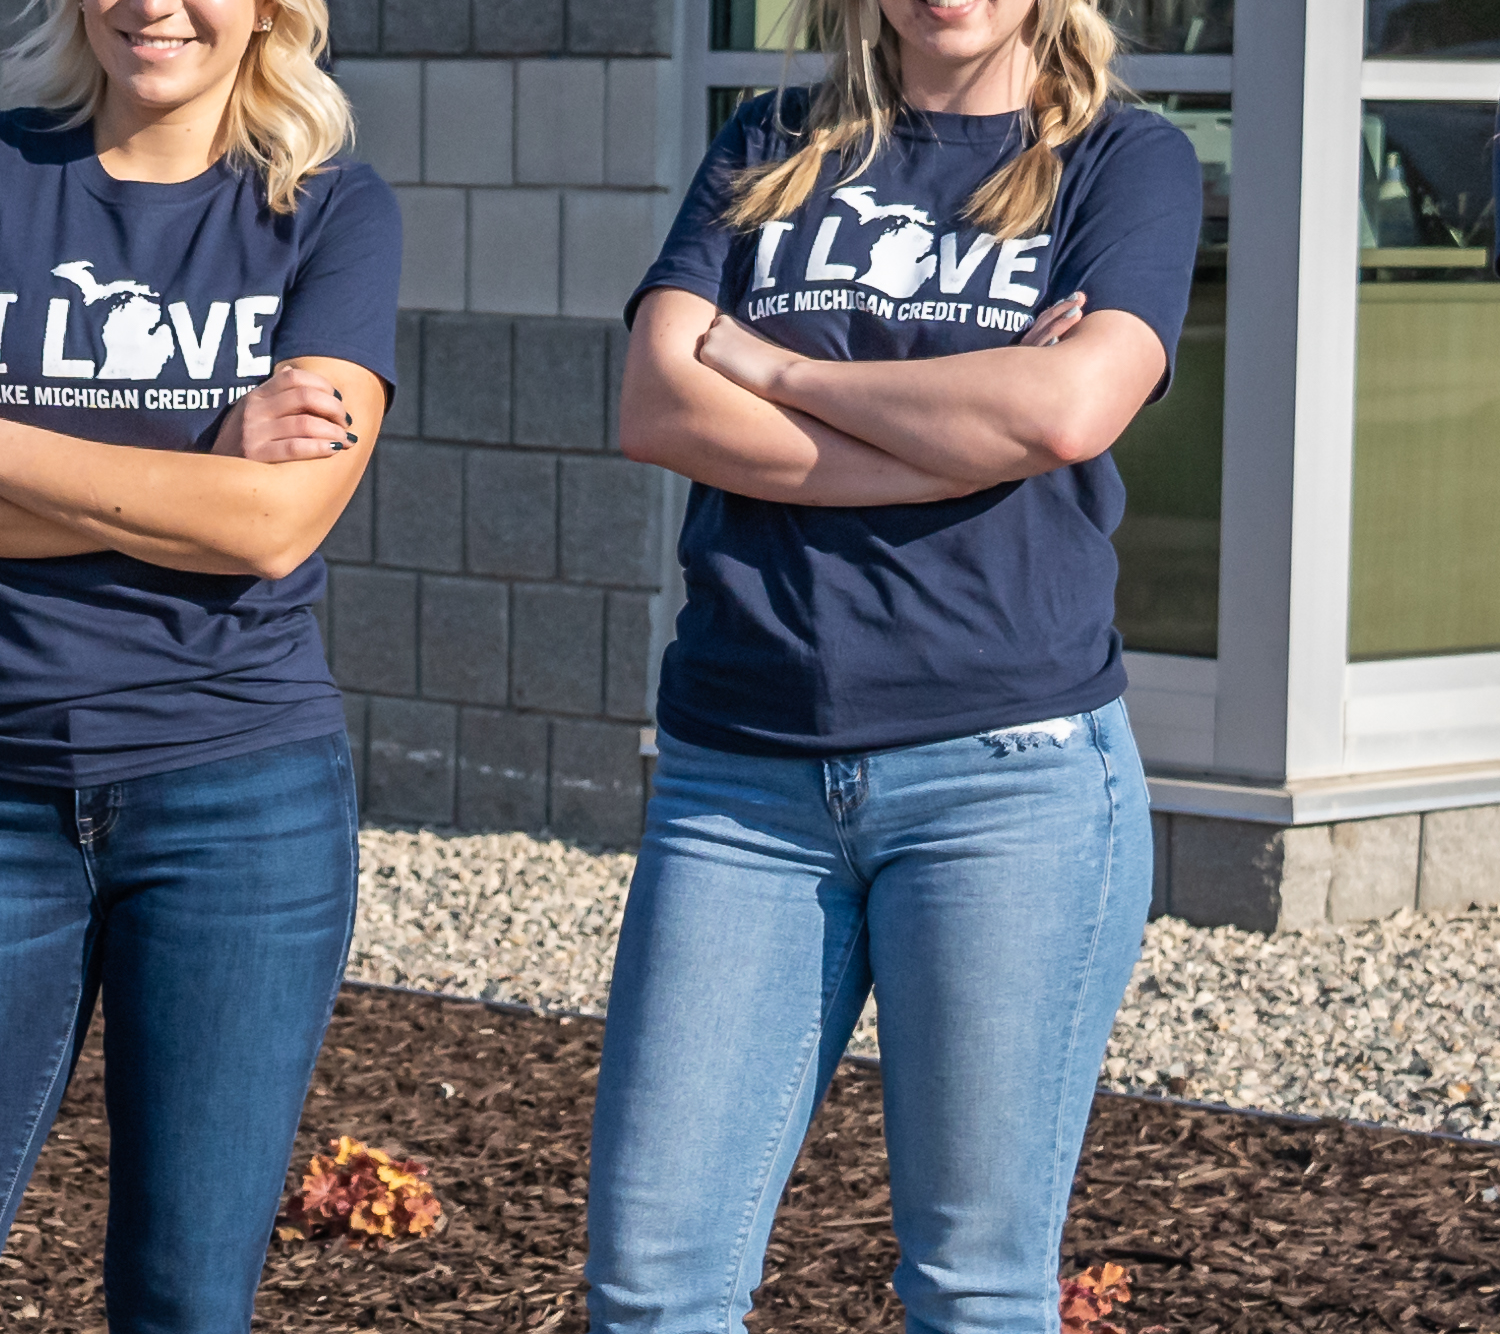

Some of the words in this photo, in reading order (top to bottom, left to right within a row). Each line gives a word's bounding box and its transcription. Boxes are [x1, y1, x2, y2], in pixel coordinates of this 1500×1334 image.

[752, 221, 794, 292] I
[748, 293, 790, 322] LAKE
[794, 289, 894, 320] MICHIGAN
[897, 301, 973, 323] CREDIT
[34, 386, 140, 409] MICHIGAN
[144, 388, 224, 410] CREDIT
